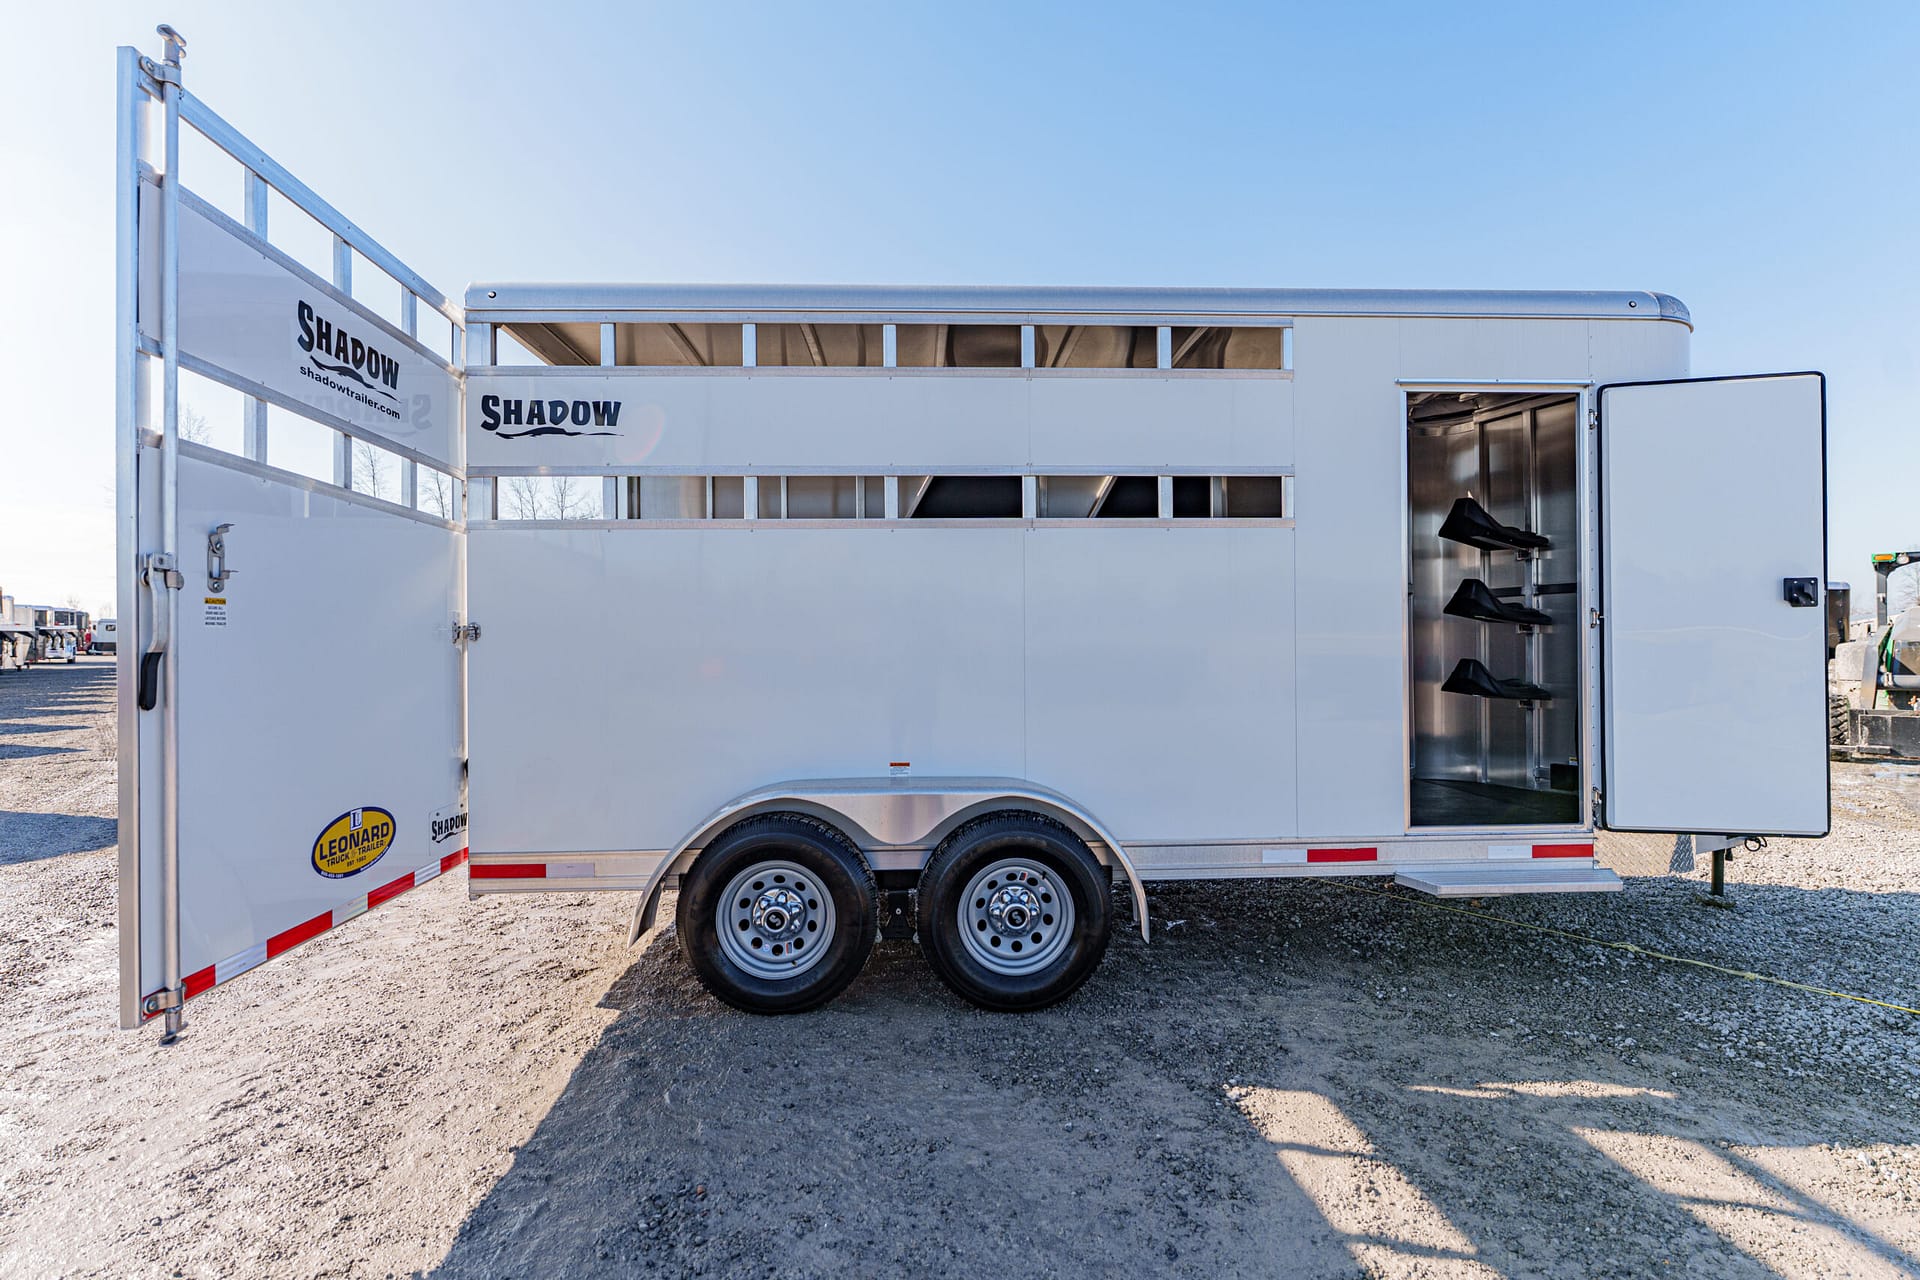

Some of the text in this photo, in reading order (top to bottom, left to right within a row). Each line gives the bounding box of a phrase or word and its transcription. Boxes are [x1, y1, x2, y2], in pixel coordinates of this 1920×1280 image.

[297, 300, 400, 390] SHADOW
[300, 366, 401, 420] shadowtrailer.com
[480, 395, 622, 431] SHADOW
[319, 822, 390, 861] LEONARD
[431, 812, 468, 841] SHADOW
[326, 851, 350, 868] TRUCK
[358, 840, 384, 855] TRAILER
